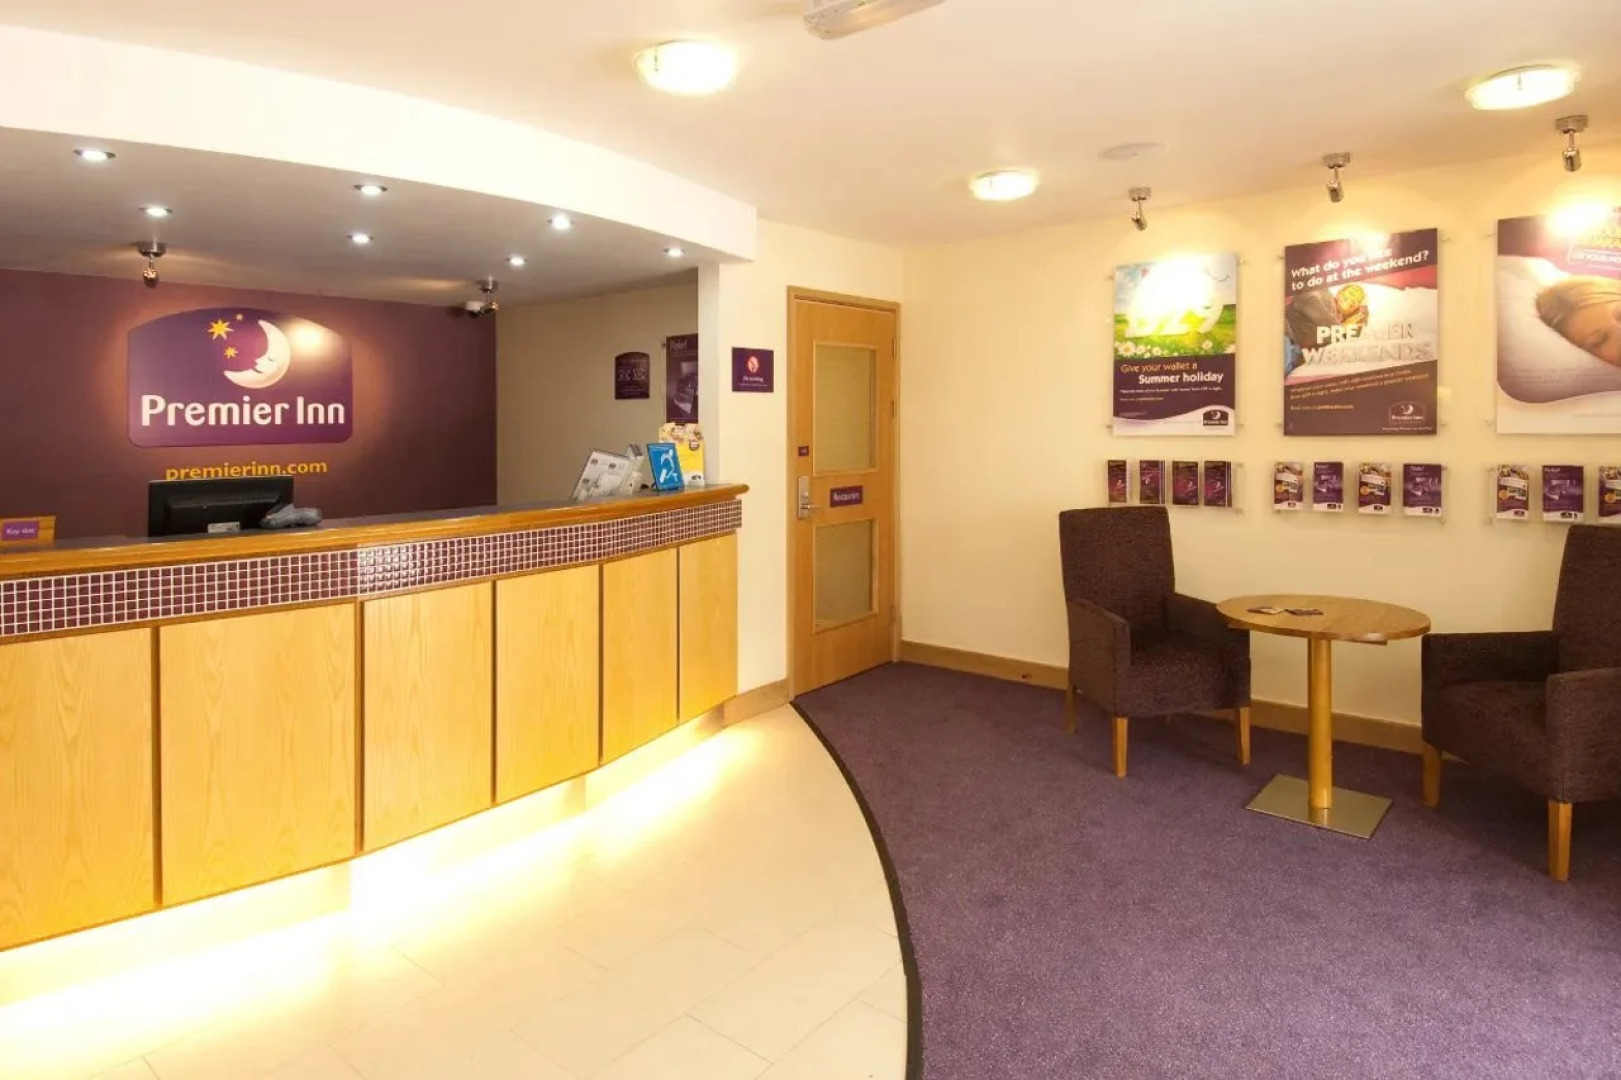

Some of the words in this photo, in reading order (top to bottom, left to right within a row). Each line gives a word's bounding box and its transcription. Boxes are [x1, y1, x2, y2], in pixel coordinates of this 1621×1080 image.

[1291, 263, 1320, 278] What
[1323, 260, 1340, 272] do
[1292, 280, 1304, 291] to
[1307, 275, 1323, 287] do
[1326, 271, 1339, 283] at
[1342, 268, 1363, 280] the
[1365, 250, 1430, 273] weekend?
[1121, 363, 1139, 373] Give
[1141, 364, 1161, 374] your
[1163, 362, 1190, 372] wallet
[1138, 373, 1180, 385] Summer
[1182, 371, 1224, 383] holiday
[141, 395, 289, 426] Premier
[297, 396, 345, 425] Inn
[165, 460, 328, 481] premierinn.com
